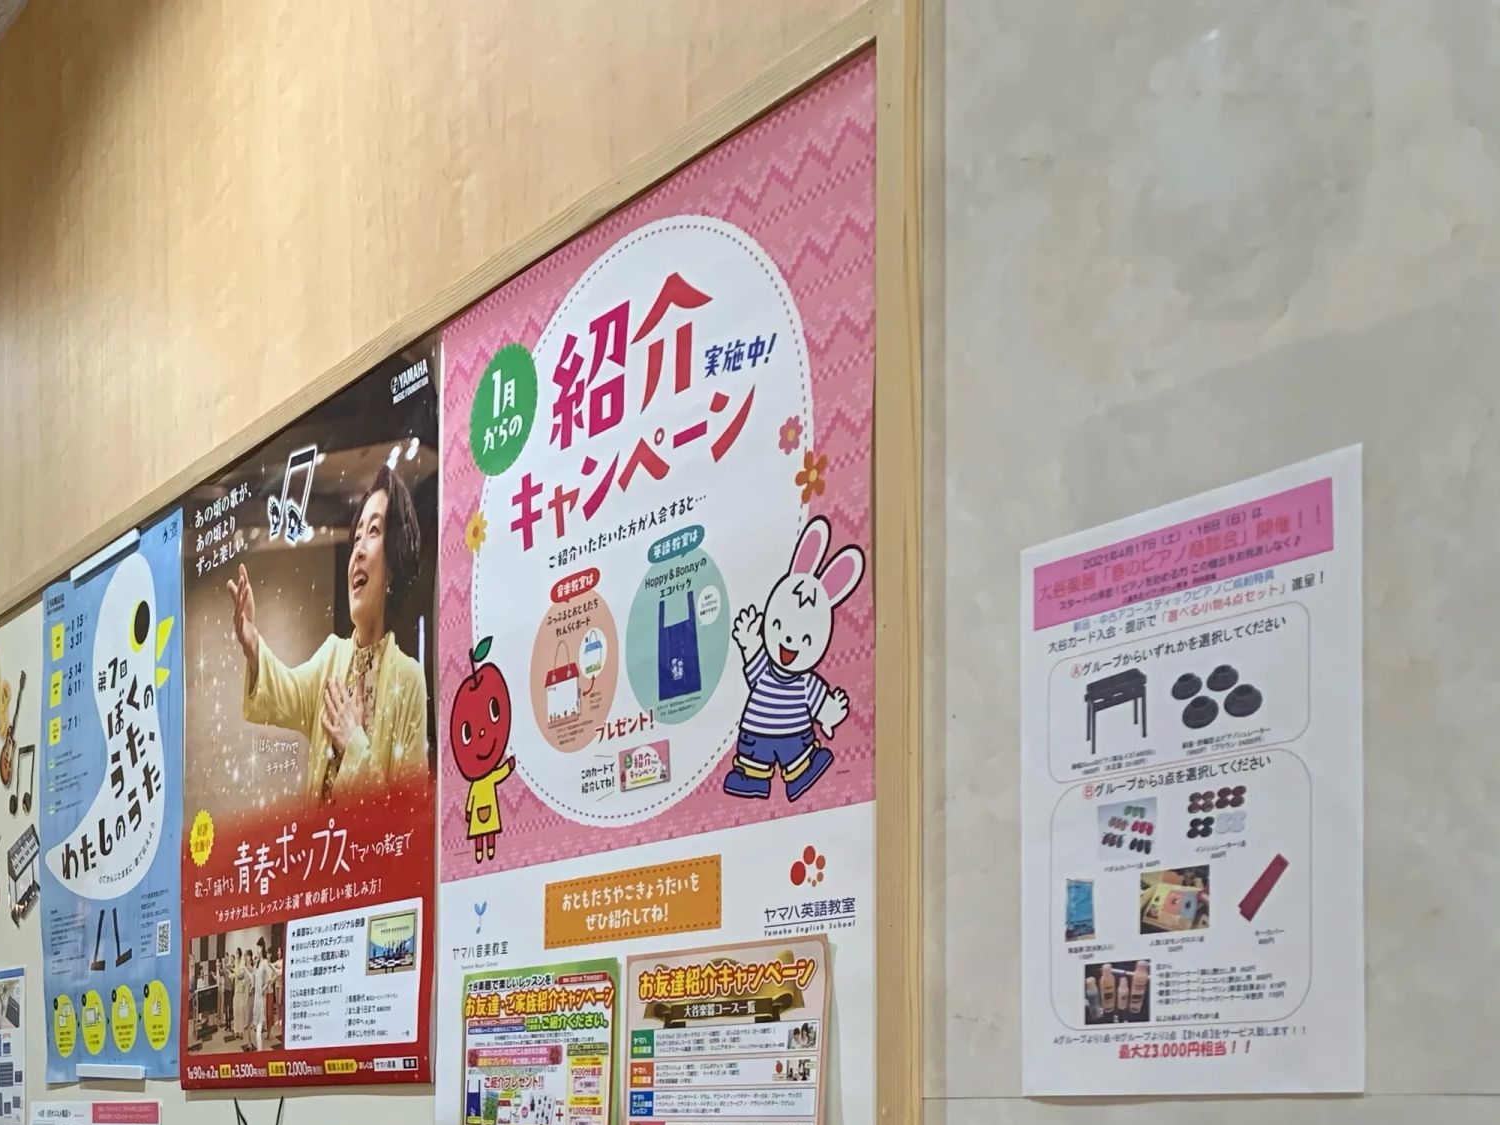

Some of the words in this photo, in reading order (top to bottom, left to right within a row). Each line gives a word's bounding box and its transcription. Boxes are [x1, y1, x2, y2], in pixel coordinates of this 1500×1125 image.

[549, 271, 714, 451] 紹介
[703, 332, 777, 380] 実施中！
[398, 358, 428, 390] YAMAHA
[491, 370, 516, 418] 1月
[483, 412, 522, 455] からの
[510, 383, 756, 552] キャンペーン
[194, 482, 251, 529] あの頃の歌が、
[195, 515, 236, 553] あの頃より
[548, 494, 707, 570] ご紹介いただいた方が入会すると…
[653, 529, 699, 558] 英語教室は
[195, 538, 248, 577] ずっと楽しい。
[556, 572, 595, 598] 音楽教室は
[659, 579, 692, 598] エコバッグ
[98, 657, 128, 693] 第7回
[595, 709, 654, 744] プレゼント！
[258, 738, 299, 757] ほら、ヤマハで
[265, 757, 299, 776] キラッキラ。
[581, 762, 615, 779] このカードで
[581, 776, 615, 794] 紹介してね！
[61, 761, 162, 880] わたしのうた
[233, 818, 350, 896] 青春ポップス
[350, 829, 415, 863] ヤマハの教室で
[561, 871, 700, 912] おともだちやごきょうだいを
[585, 901, 669, 932] ぜひ紹介してね！
[764, 897, 856, 923] ヤマハ英語教室
[764, 927, 792, 937] Yamaha
[796, 923, 825, 934] English
[828, 919, 856, 930] School
[453, 942, 508, 961] ヤマハ音楽教室
[639, 958, 816, 1001] お友達紹介キャンペーン
[465, 986, 615, 1019] お友達・ご家族紹介キャンペーン
[683, 1001, 756, 1018] 大谷楽器コース一覧
[541, 1012, 609, 1031] ご紹介ください。
